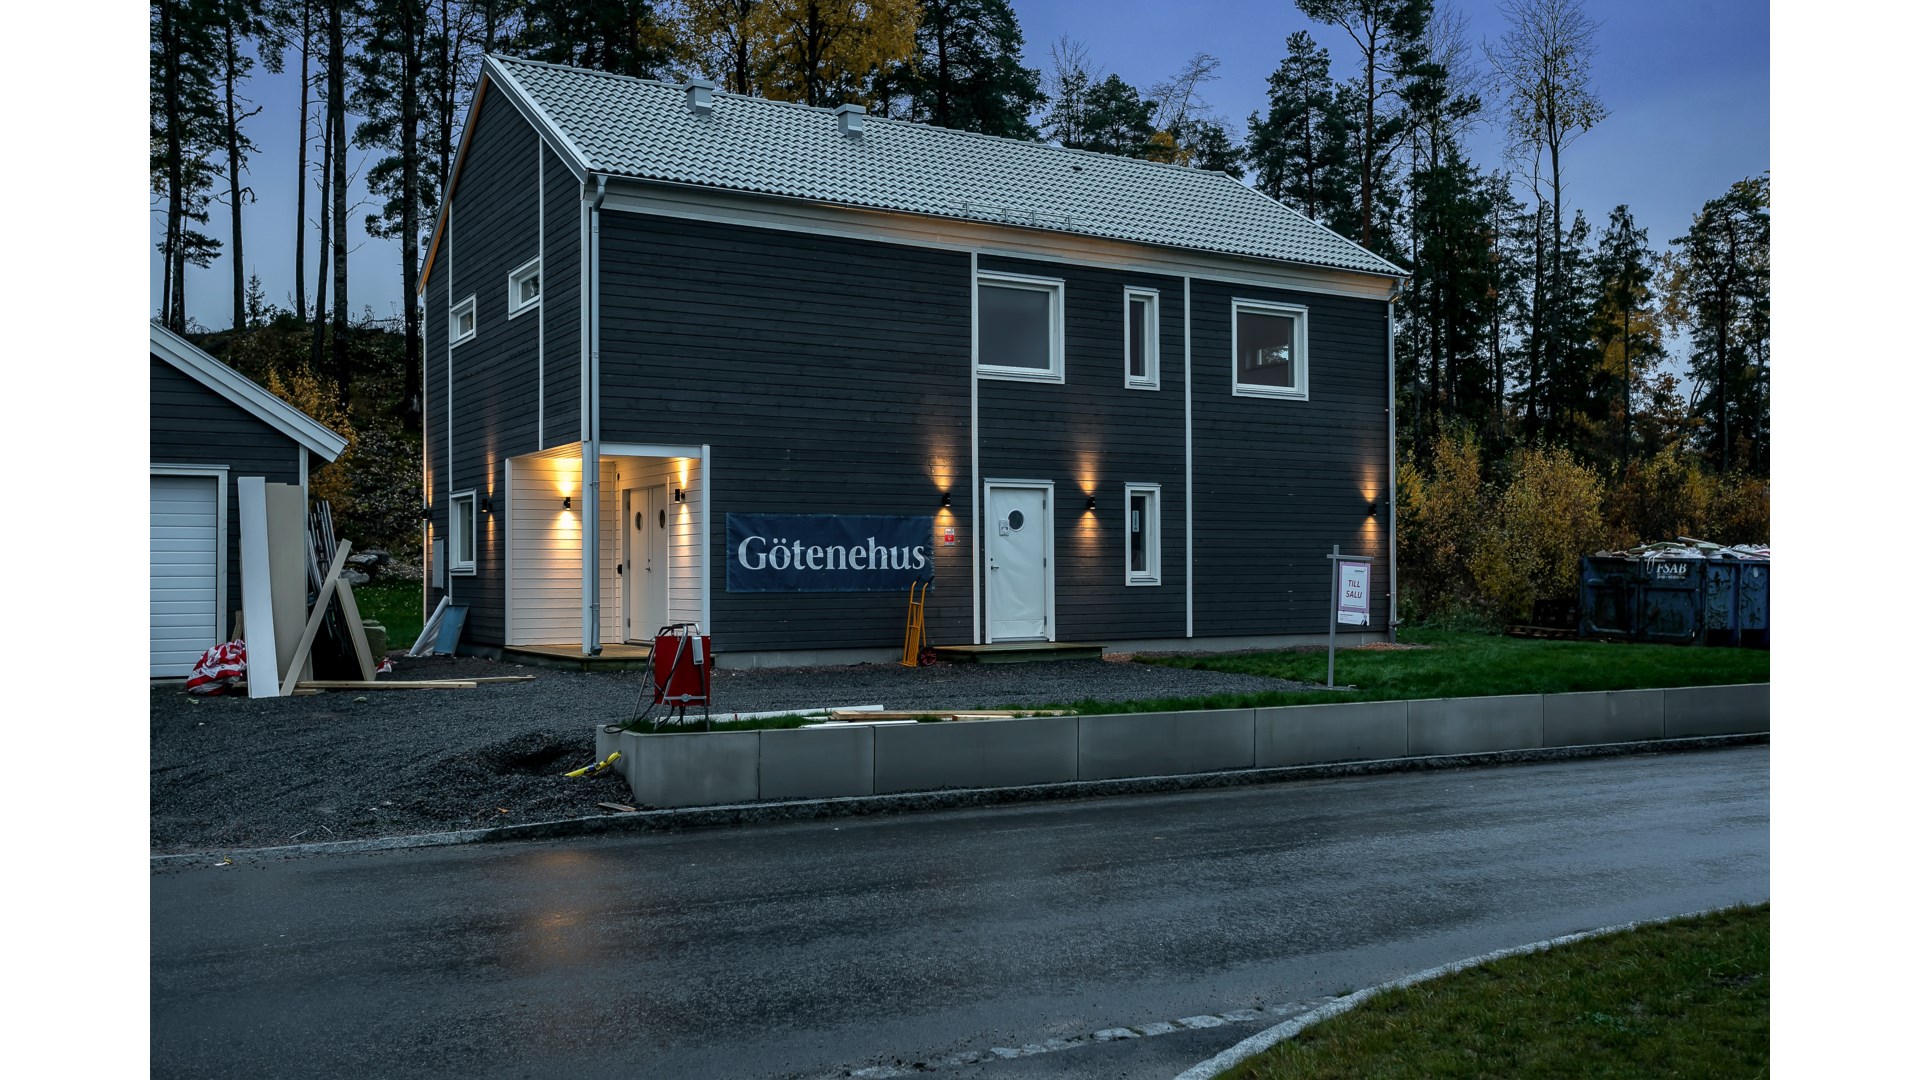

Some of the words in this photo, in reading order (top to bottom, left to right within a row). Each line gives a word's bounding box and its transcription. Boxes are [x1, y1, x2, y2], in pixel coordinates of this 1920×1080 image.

[738, 535, 926, 570] Götenehus
[1348, 579, 1361, 588] TILL
[1345, 590, 1363, 599] SALU
